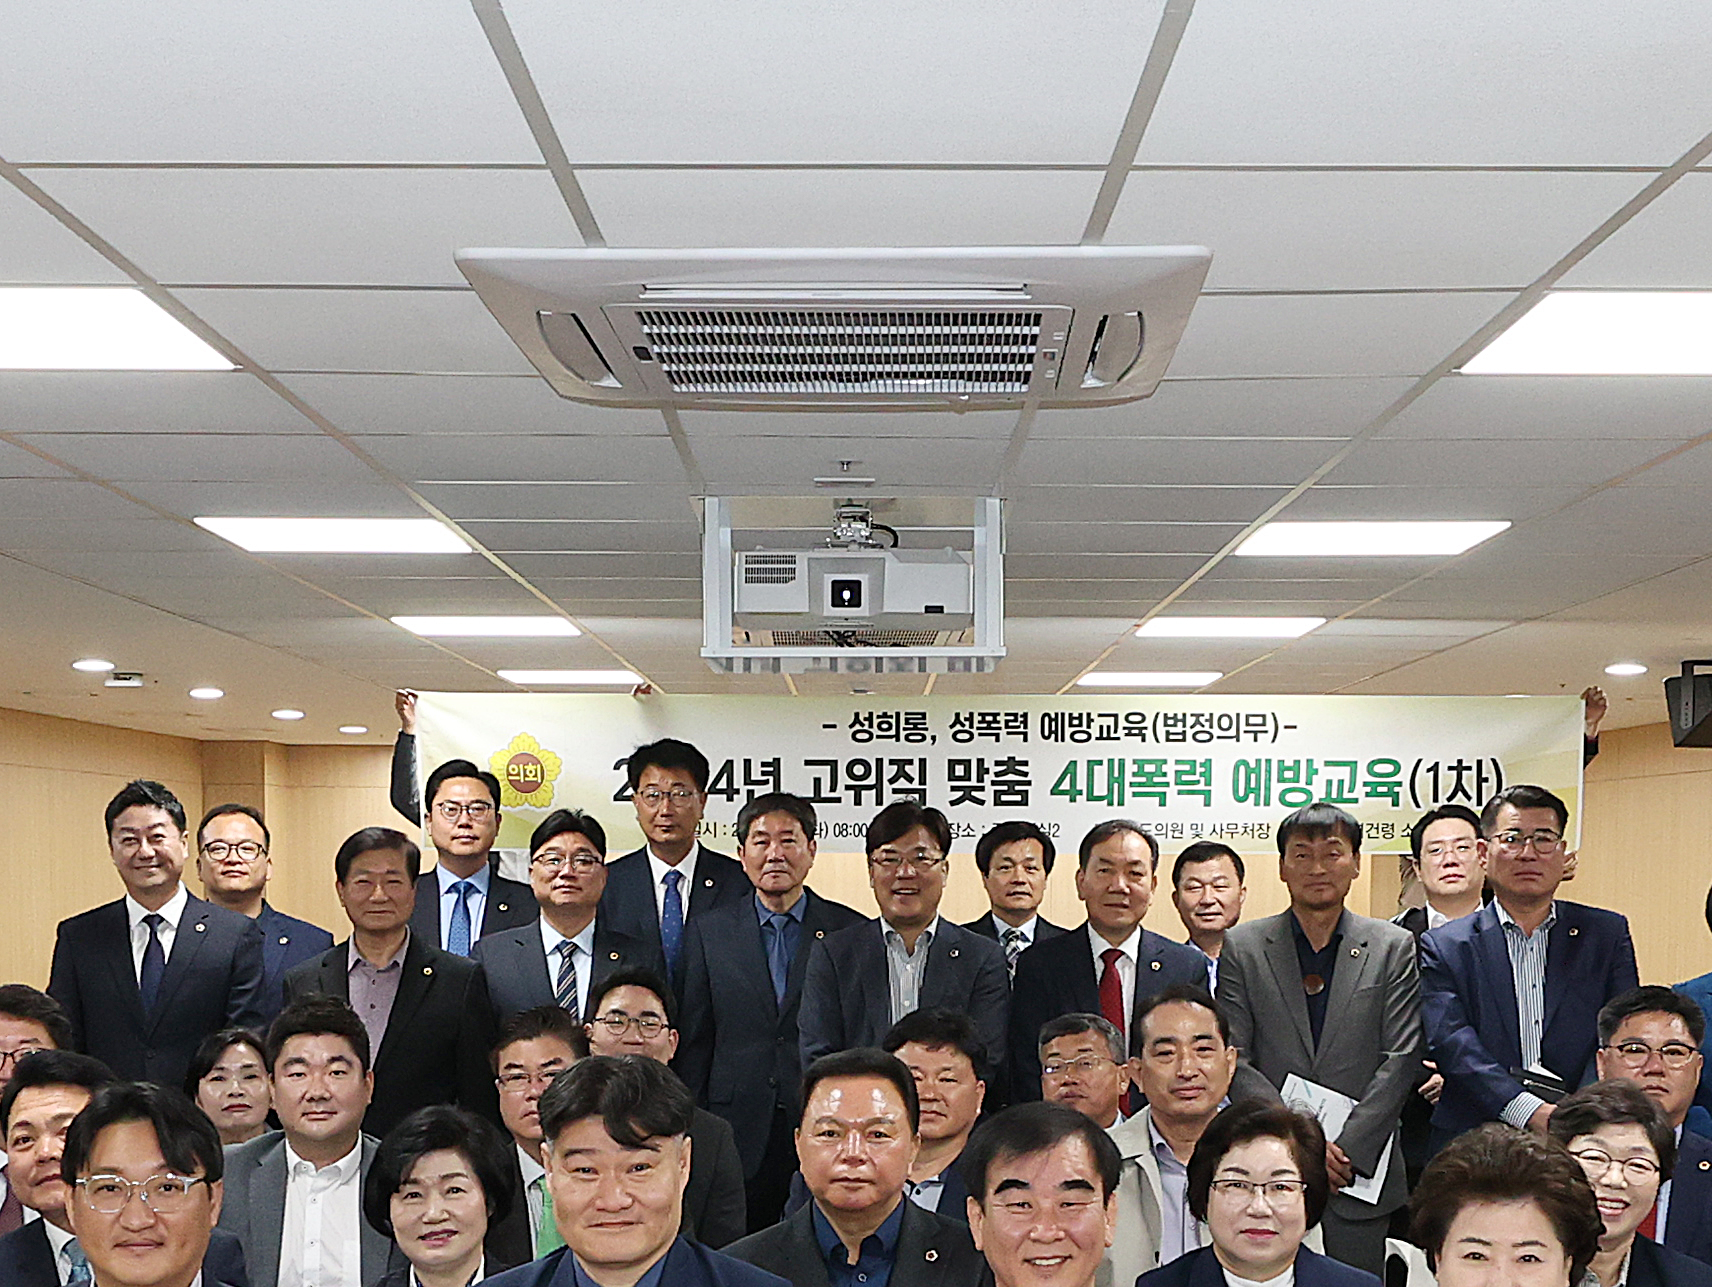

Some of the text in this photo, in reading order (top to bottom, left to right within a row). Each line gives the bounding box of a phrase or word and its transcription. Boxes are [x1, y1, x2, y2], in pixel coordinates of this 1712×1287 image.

[848, 711, 937, 746] 성희롱,
[949, 711, 1029, 743] 성폭력
[508, 763, 541, 783] 의회
[612, 756, 1503, 808] 24년 고위직 맞춤 4대폭력 예방교육(1차)
[1190, 823, 1204, 839] 및
[1209, 823, 1271, 839] 사무처장
